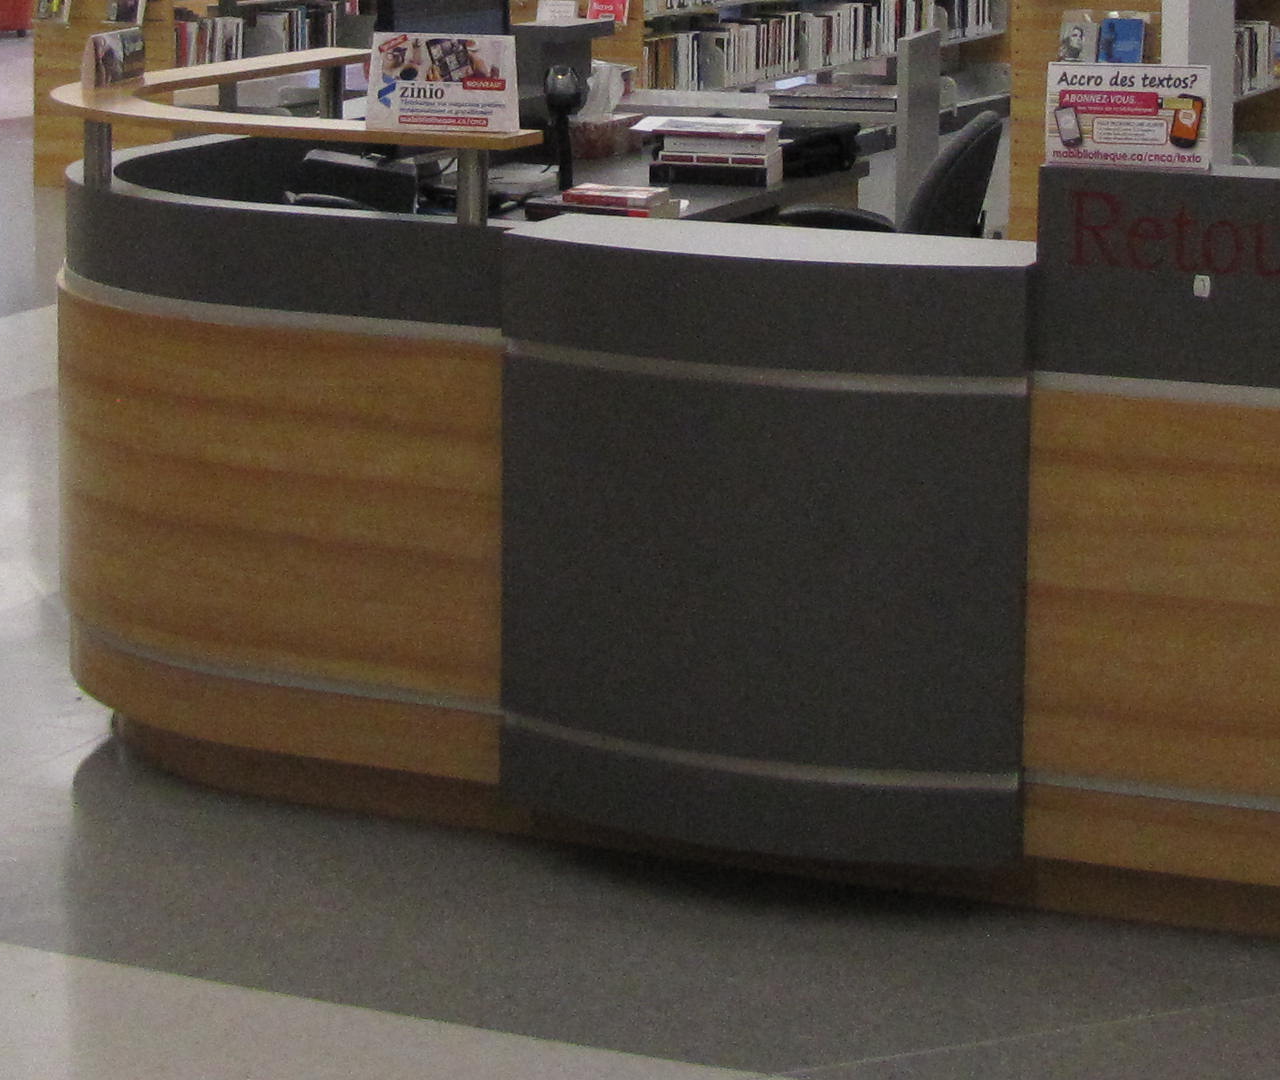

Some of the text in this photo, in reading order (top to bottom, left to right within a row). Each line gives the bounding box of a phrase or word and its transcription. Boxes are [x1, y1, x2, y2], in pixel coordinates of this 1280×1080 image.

[1057, 71, 1198, 89] Accro des textos?
[399, 83, 445, 99] zinio
